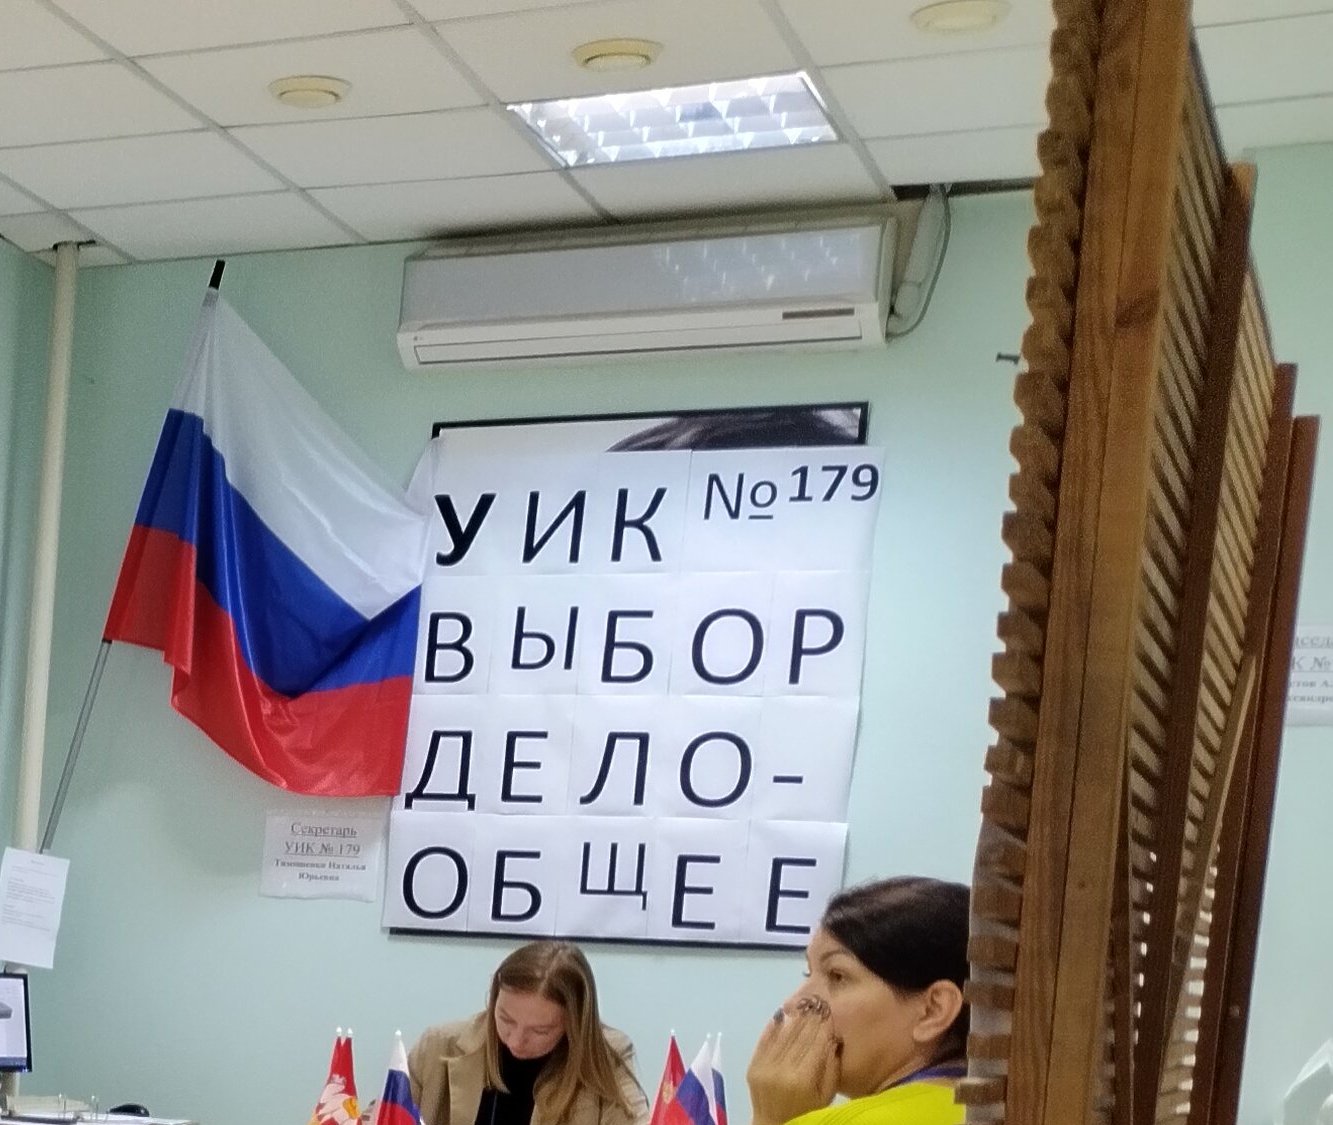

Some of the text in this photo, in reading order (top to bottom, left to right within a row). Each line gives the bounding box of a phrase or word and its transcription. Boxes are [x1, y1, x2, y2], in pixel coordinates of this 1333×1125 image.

[434, 487, 667, 566] УИК
[424, 605, 845, 684] ВЫБОР
[285, 842, 315, 854] УИК
[339, 844, 360, 855] 179
[291, 822, 357, 838] Секретарь
[402, 841, 817, 933] ОБЩЕЕ
